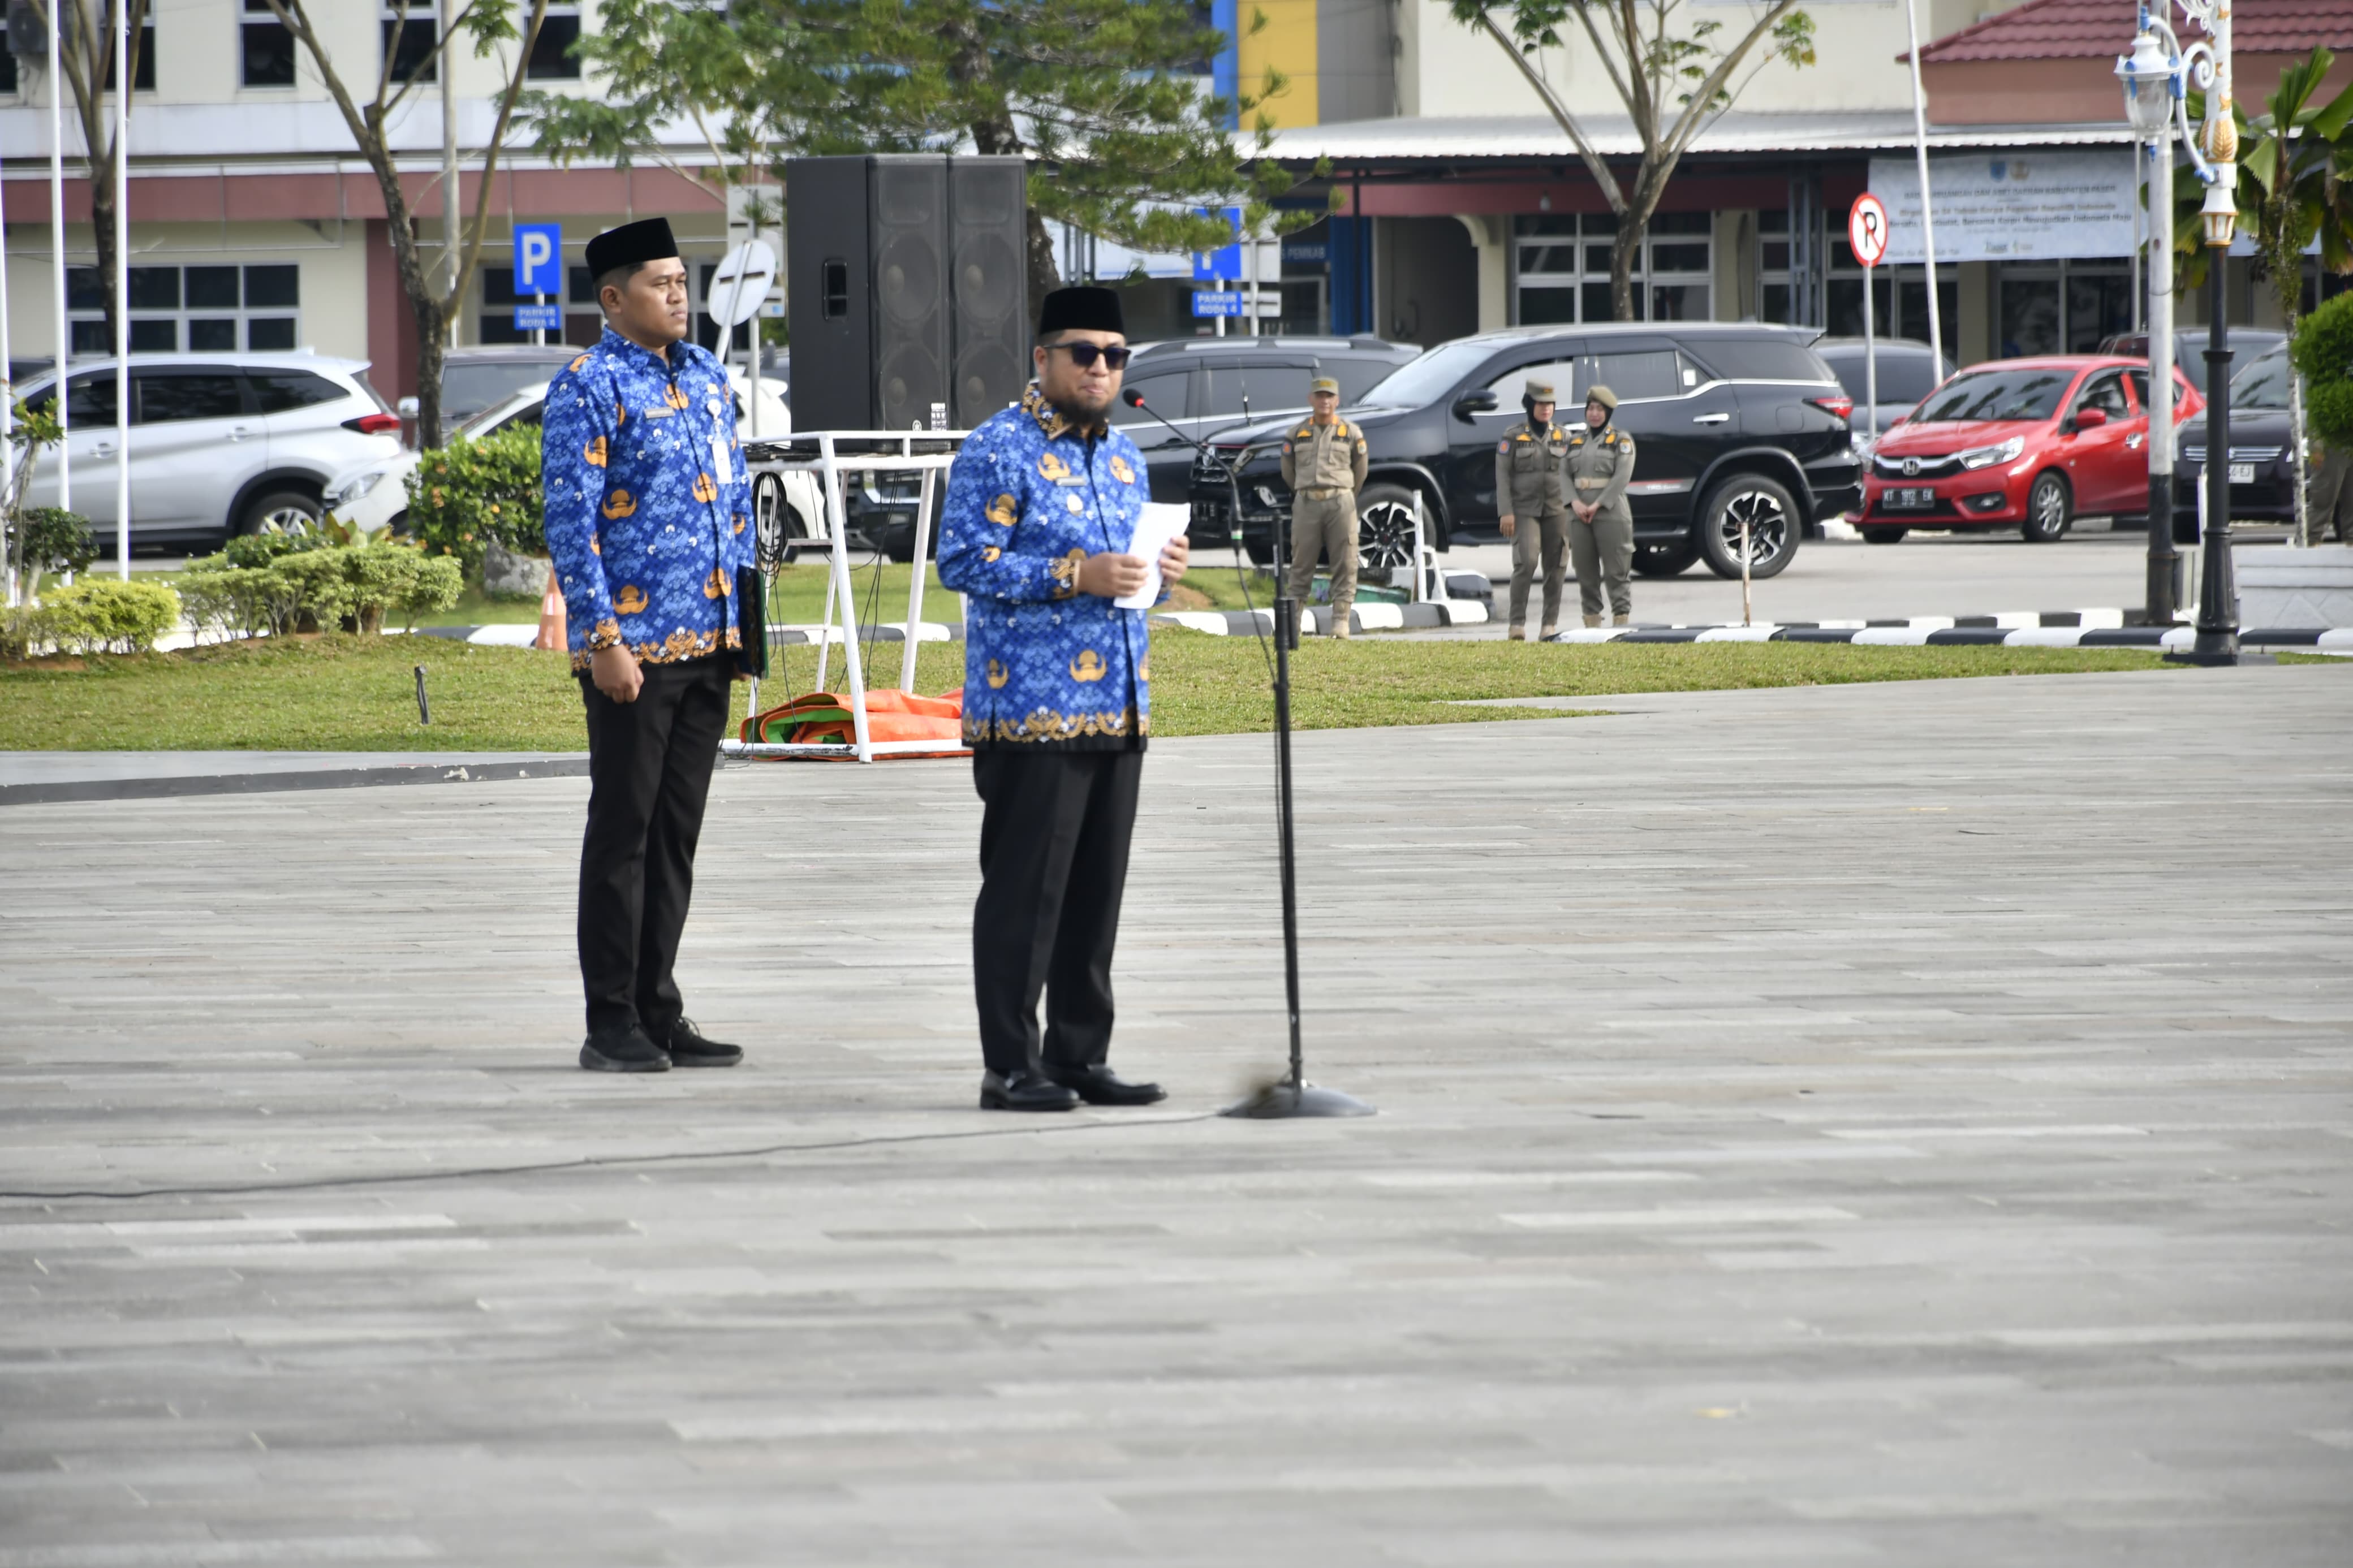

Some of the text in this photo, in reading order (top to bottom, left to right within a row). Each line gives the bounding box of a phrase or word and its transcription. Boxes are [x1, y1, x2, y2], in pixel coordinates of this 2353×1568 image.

[1863, 211, 1877, 249] P
[522, 231, 551, 285] P
[1197, 294, 1237, 303] PARKIR
[519, 308, 556, 317] PARKIR
[1198, 304, 1237, 314] RODA 4
[1884, 488, 1894, 502] KT
